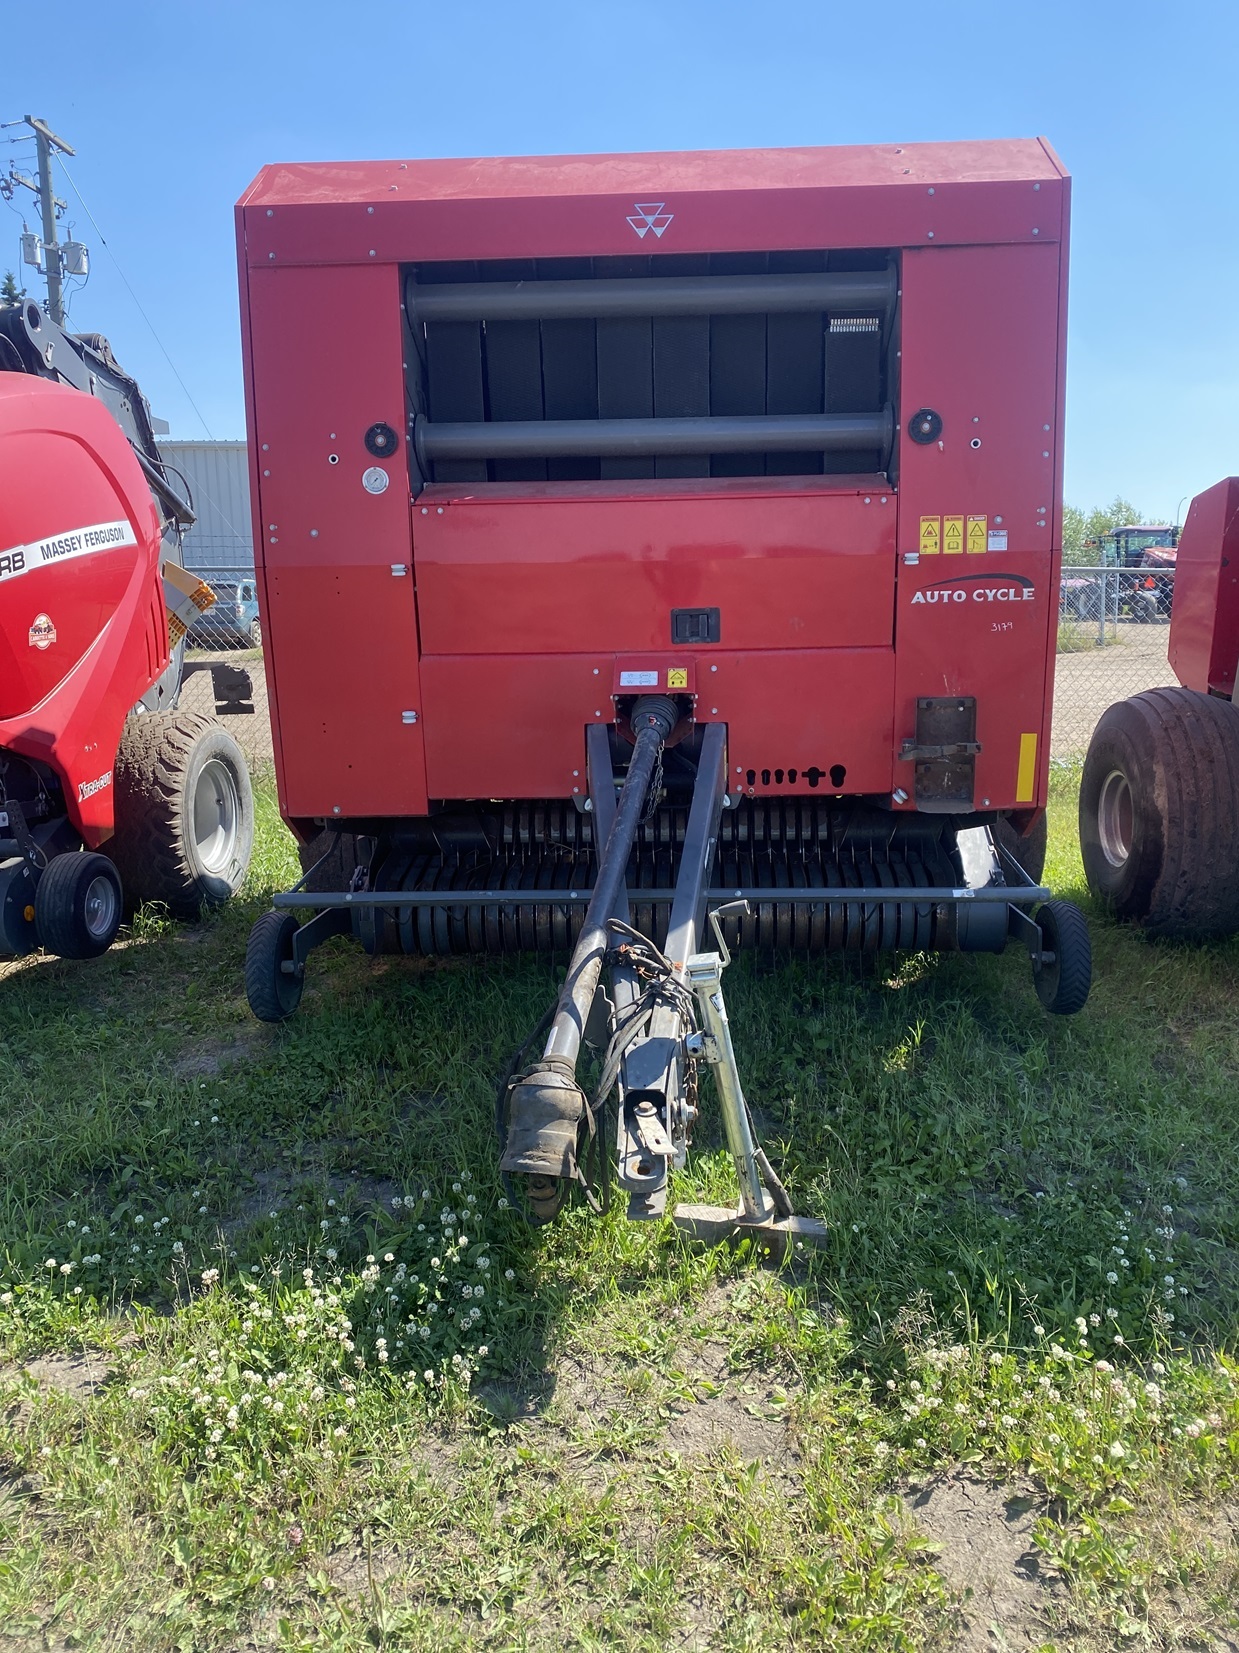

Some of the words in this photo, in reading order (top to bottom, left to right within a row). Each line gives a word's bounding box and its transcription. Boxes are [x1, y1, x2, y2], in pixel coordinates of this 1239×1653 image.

[40, 535, 82, 560] MASSEY
[84, 527, 125, 547] FERGUSON
[911, 590, 967, 604] AUTO
[972, 588, 1035, 602] CYCLE
[990, 622, 1013, 632] 3179
